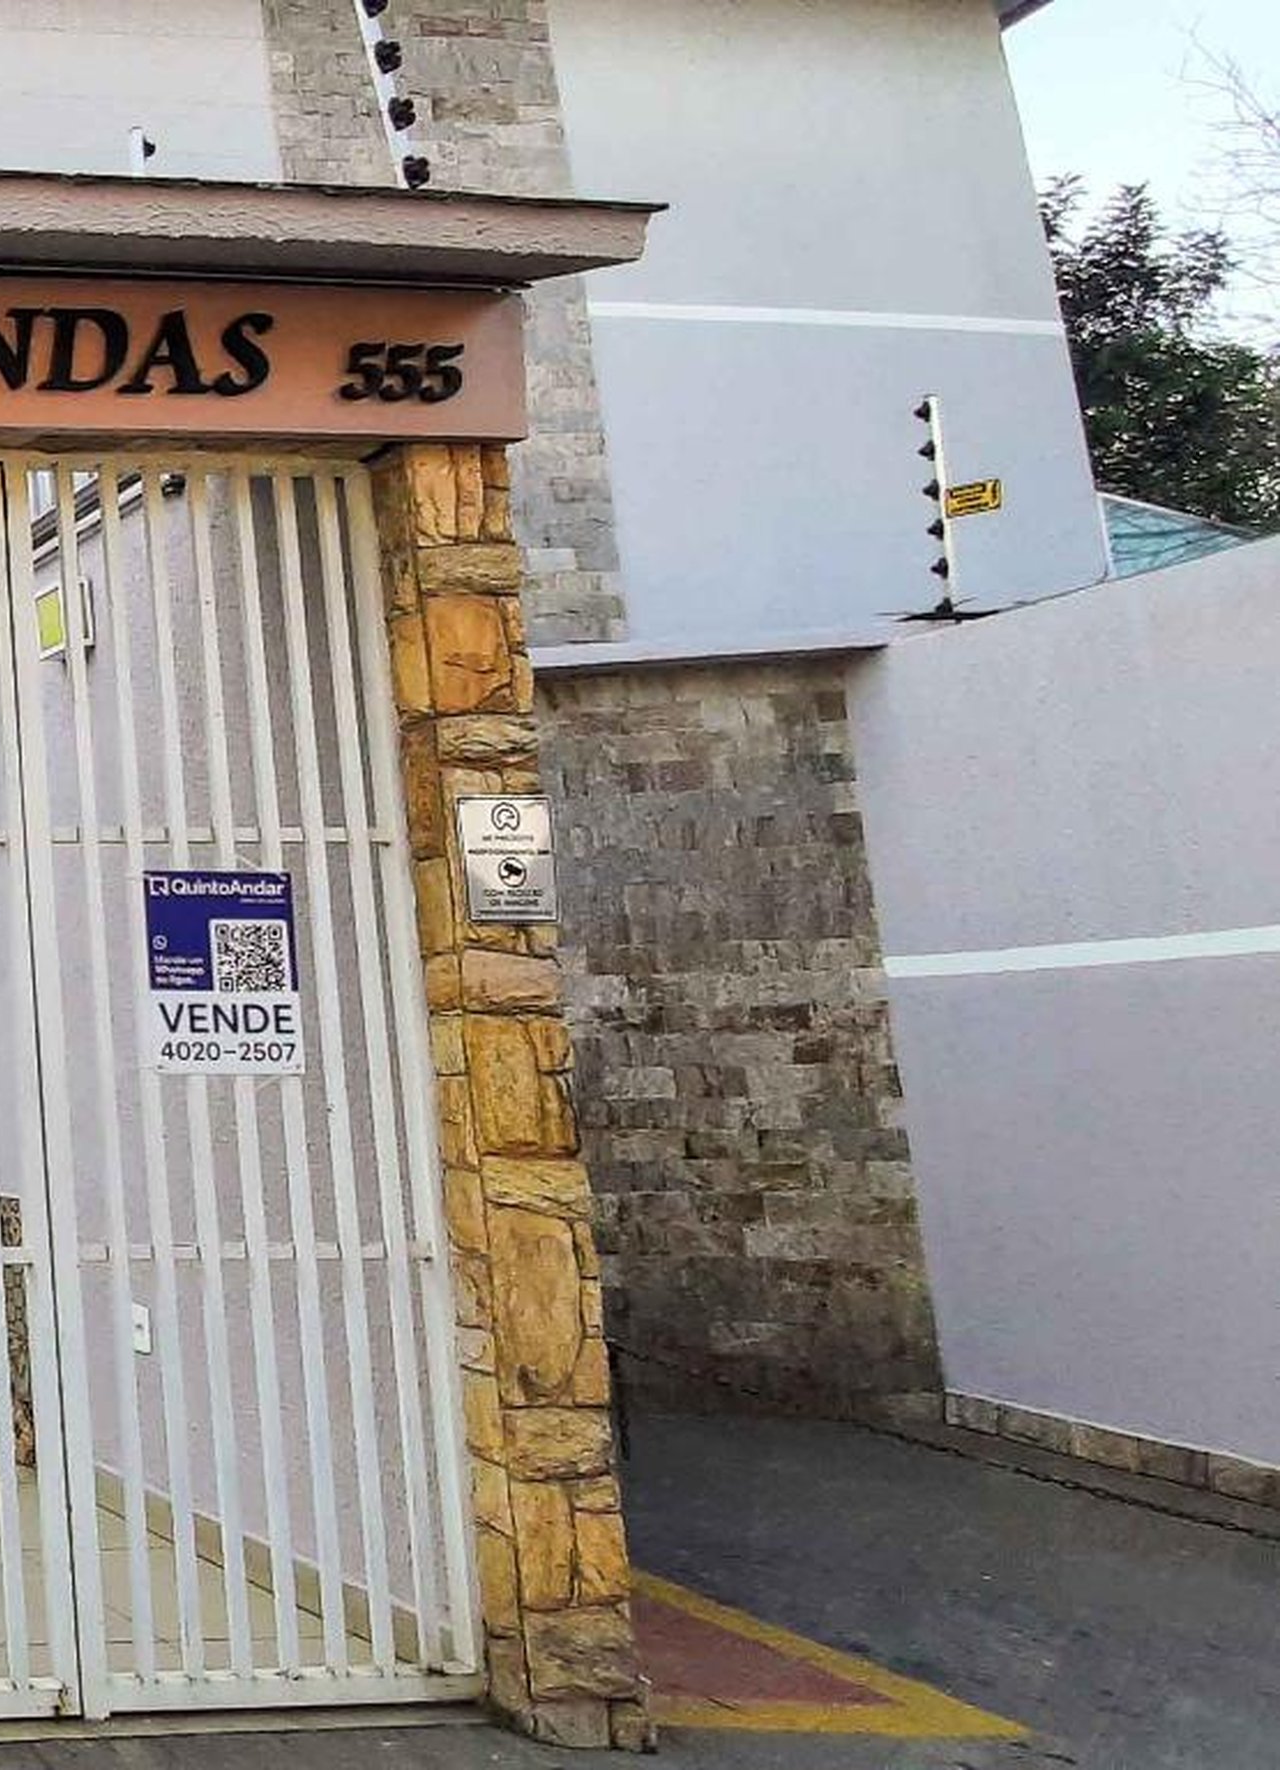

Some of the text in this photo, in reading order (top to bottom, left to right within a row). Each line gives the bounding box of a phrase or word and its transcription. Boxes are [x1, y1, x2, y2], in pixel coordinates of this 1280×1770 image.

[338, 341, 465, 403] 555
[171, 878, 285, 896] QuintoAndar
[158, 1002, 295, 1034] VENDE
[161, 1041, 296, 1062] 4020-2507
